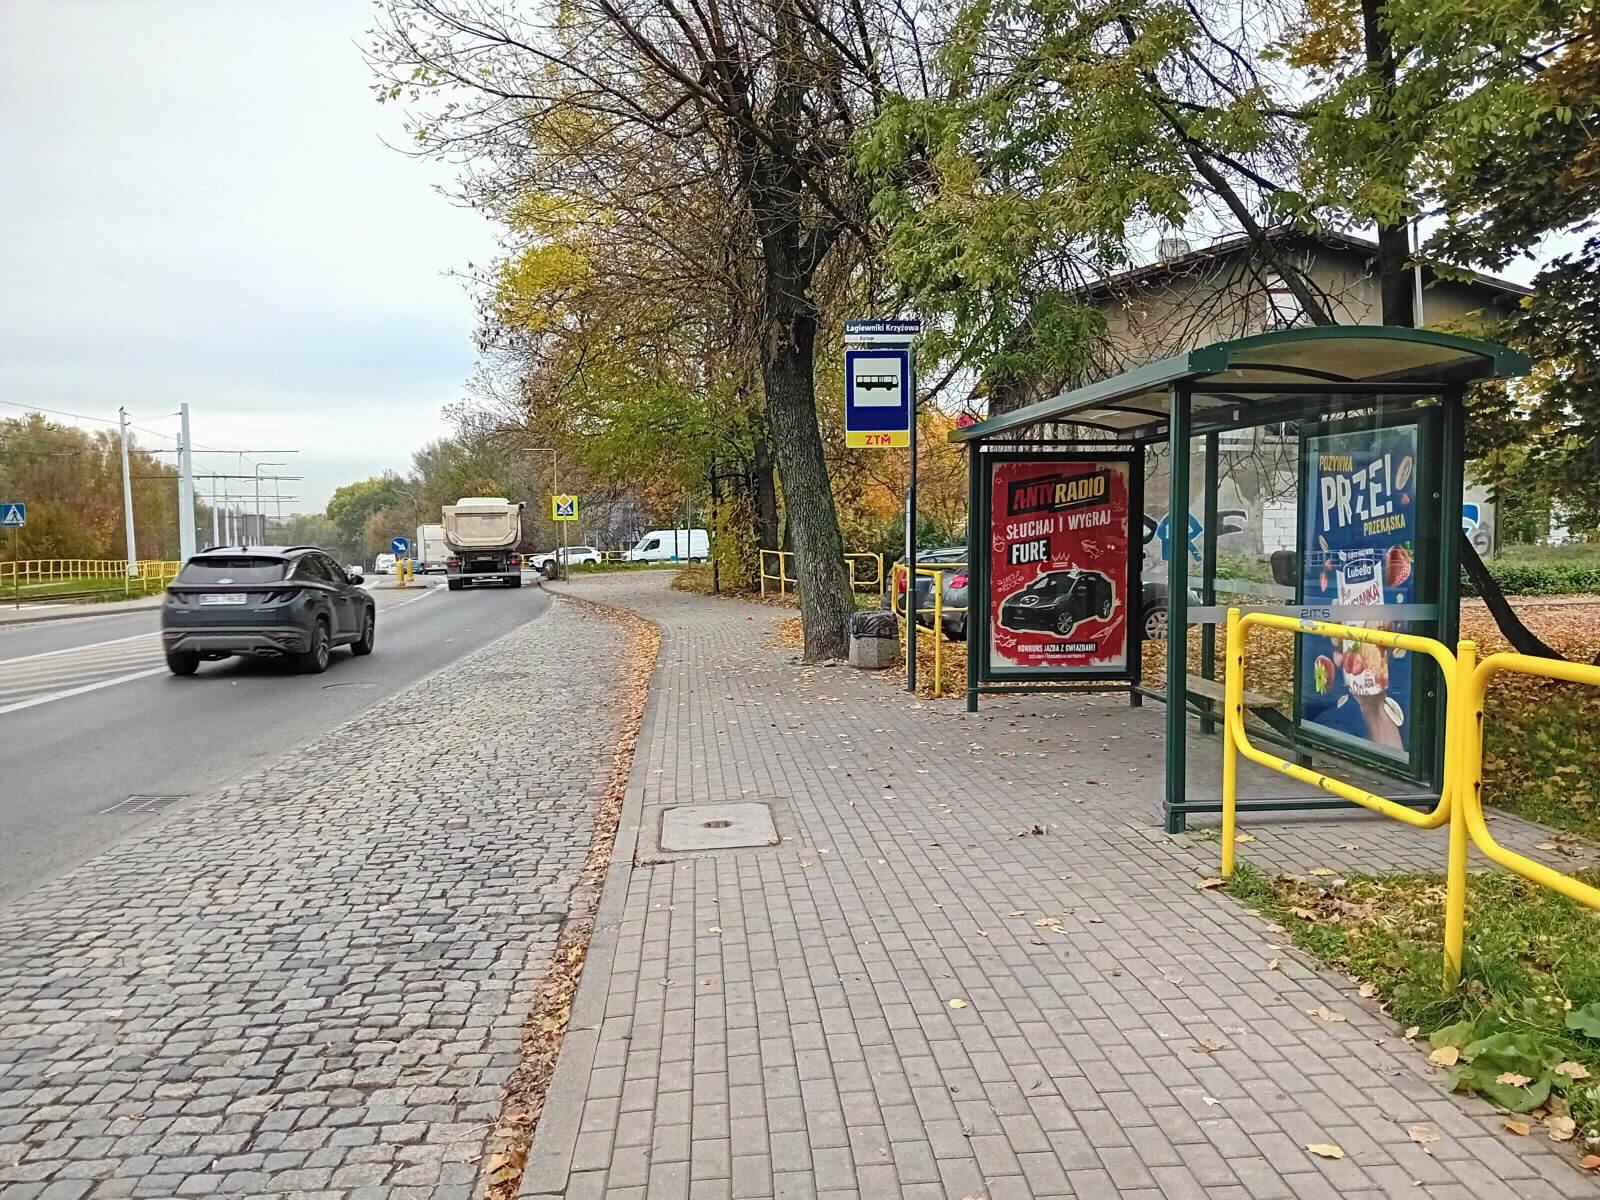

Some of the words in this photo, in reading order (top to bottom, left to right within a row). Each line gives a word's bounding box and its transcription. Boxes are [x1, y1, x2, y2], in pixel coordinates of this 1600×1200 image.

[846, 323, 884, 333] Łagiewniki
[886, 323, 919, 333] Krzyżowa
[865, 434, 891, 445] ZTM
[1320, 453, 1394, 531] PRZE!
[1006, 518, 1054, 540] SŁUCHAJ
[1058, 515, 1063, 533] I
[1067, 509, 1111, 531] WYGRAJ
[1363, 513, 1406, 536] PRZEKĄSKA
[1012, 540, 1048, 566] FURĘ
[1347, 564, 1371, 578] Lubella
